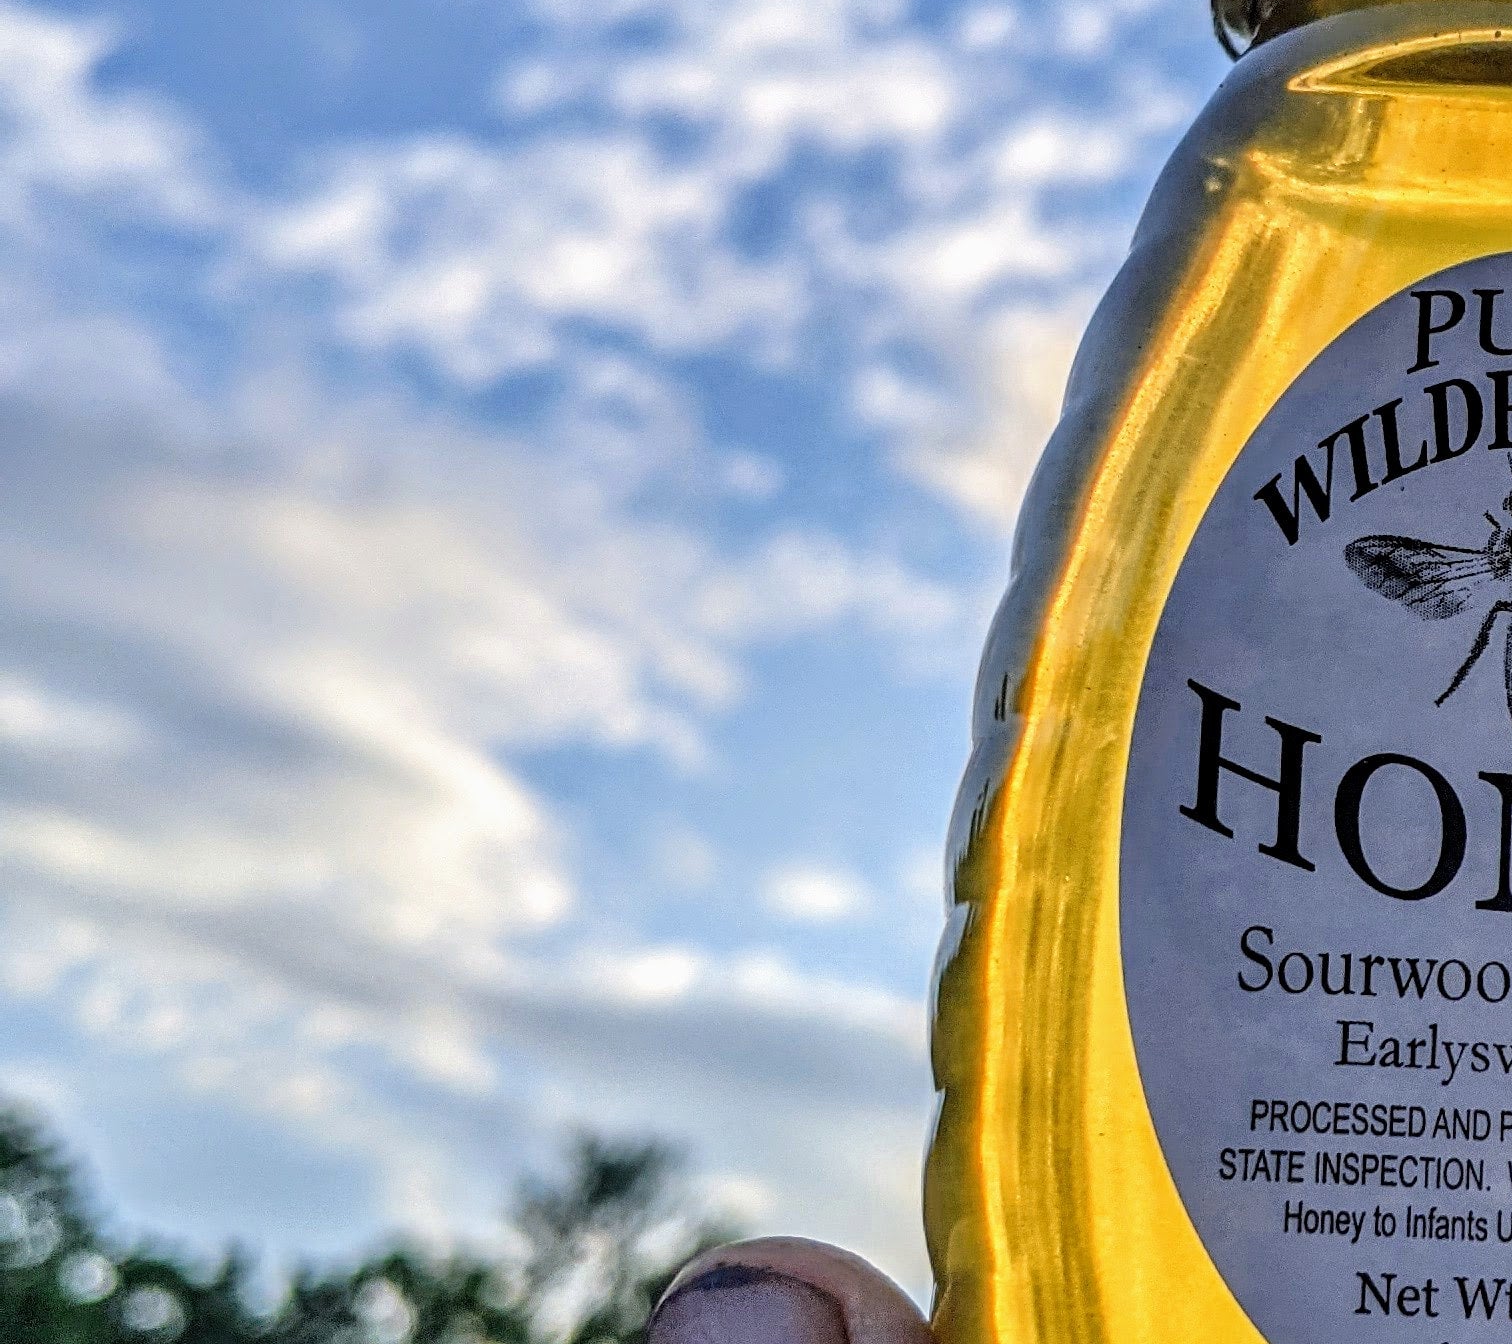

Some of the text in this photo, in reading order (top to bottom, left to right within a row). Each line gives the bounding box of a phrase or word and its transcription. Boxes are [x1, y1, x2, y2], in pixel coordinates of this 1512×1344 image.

[1250, 1100, 1426, 1138] PROCESSED
[1432, 1108, 1491, 1140] AND
[1219, 1148, 1304, 1184] STATE
[1314, 1151, 1492, 1192] INSPECTION.
[1284, 1201, 1363, 1243] Honey
[1373, 1208, 1396, 1237] to
[1405, 1206, 1488, 1242] Infants
[1355, 1272, 1439, 1317] Net
